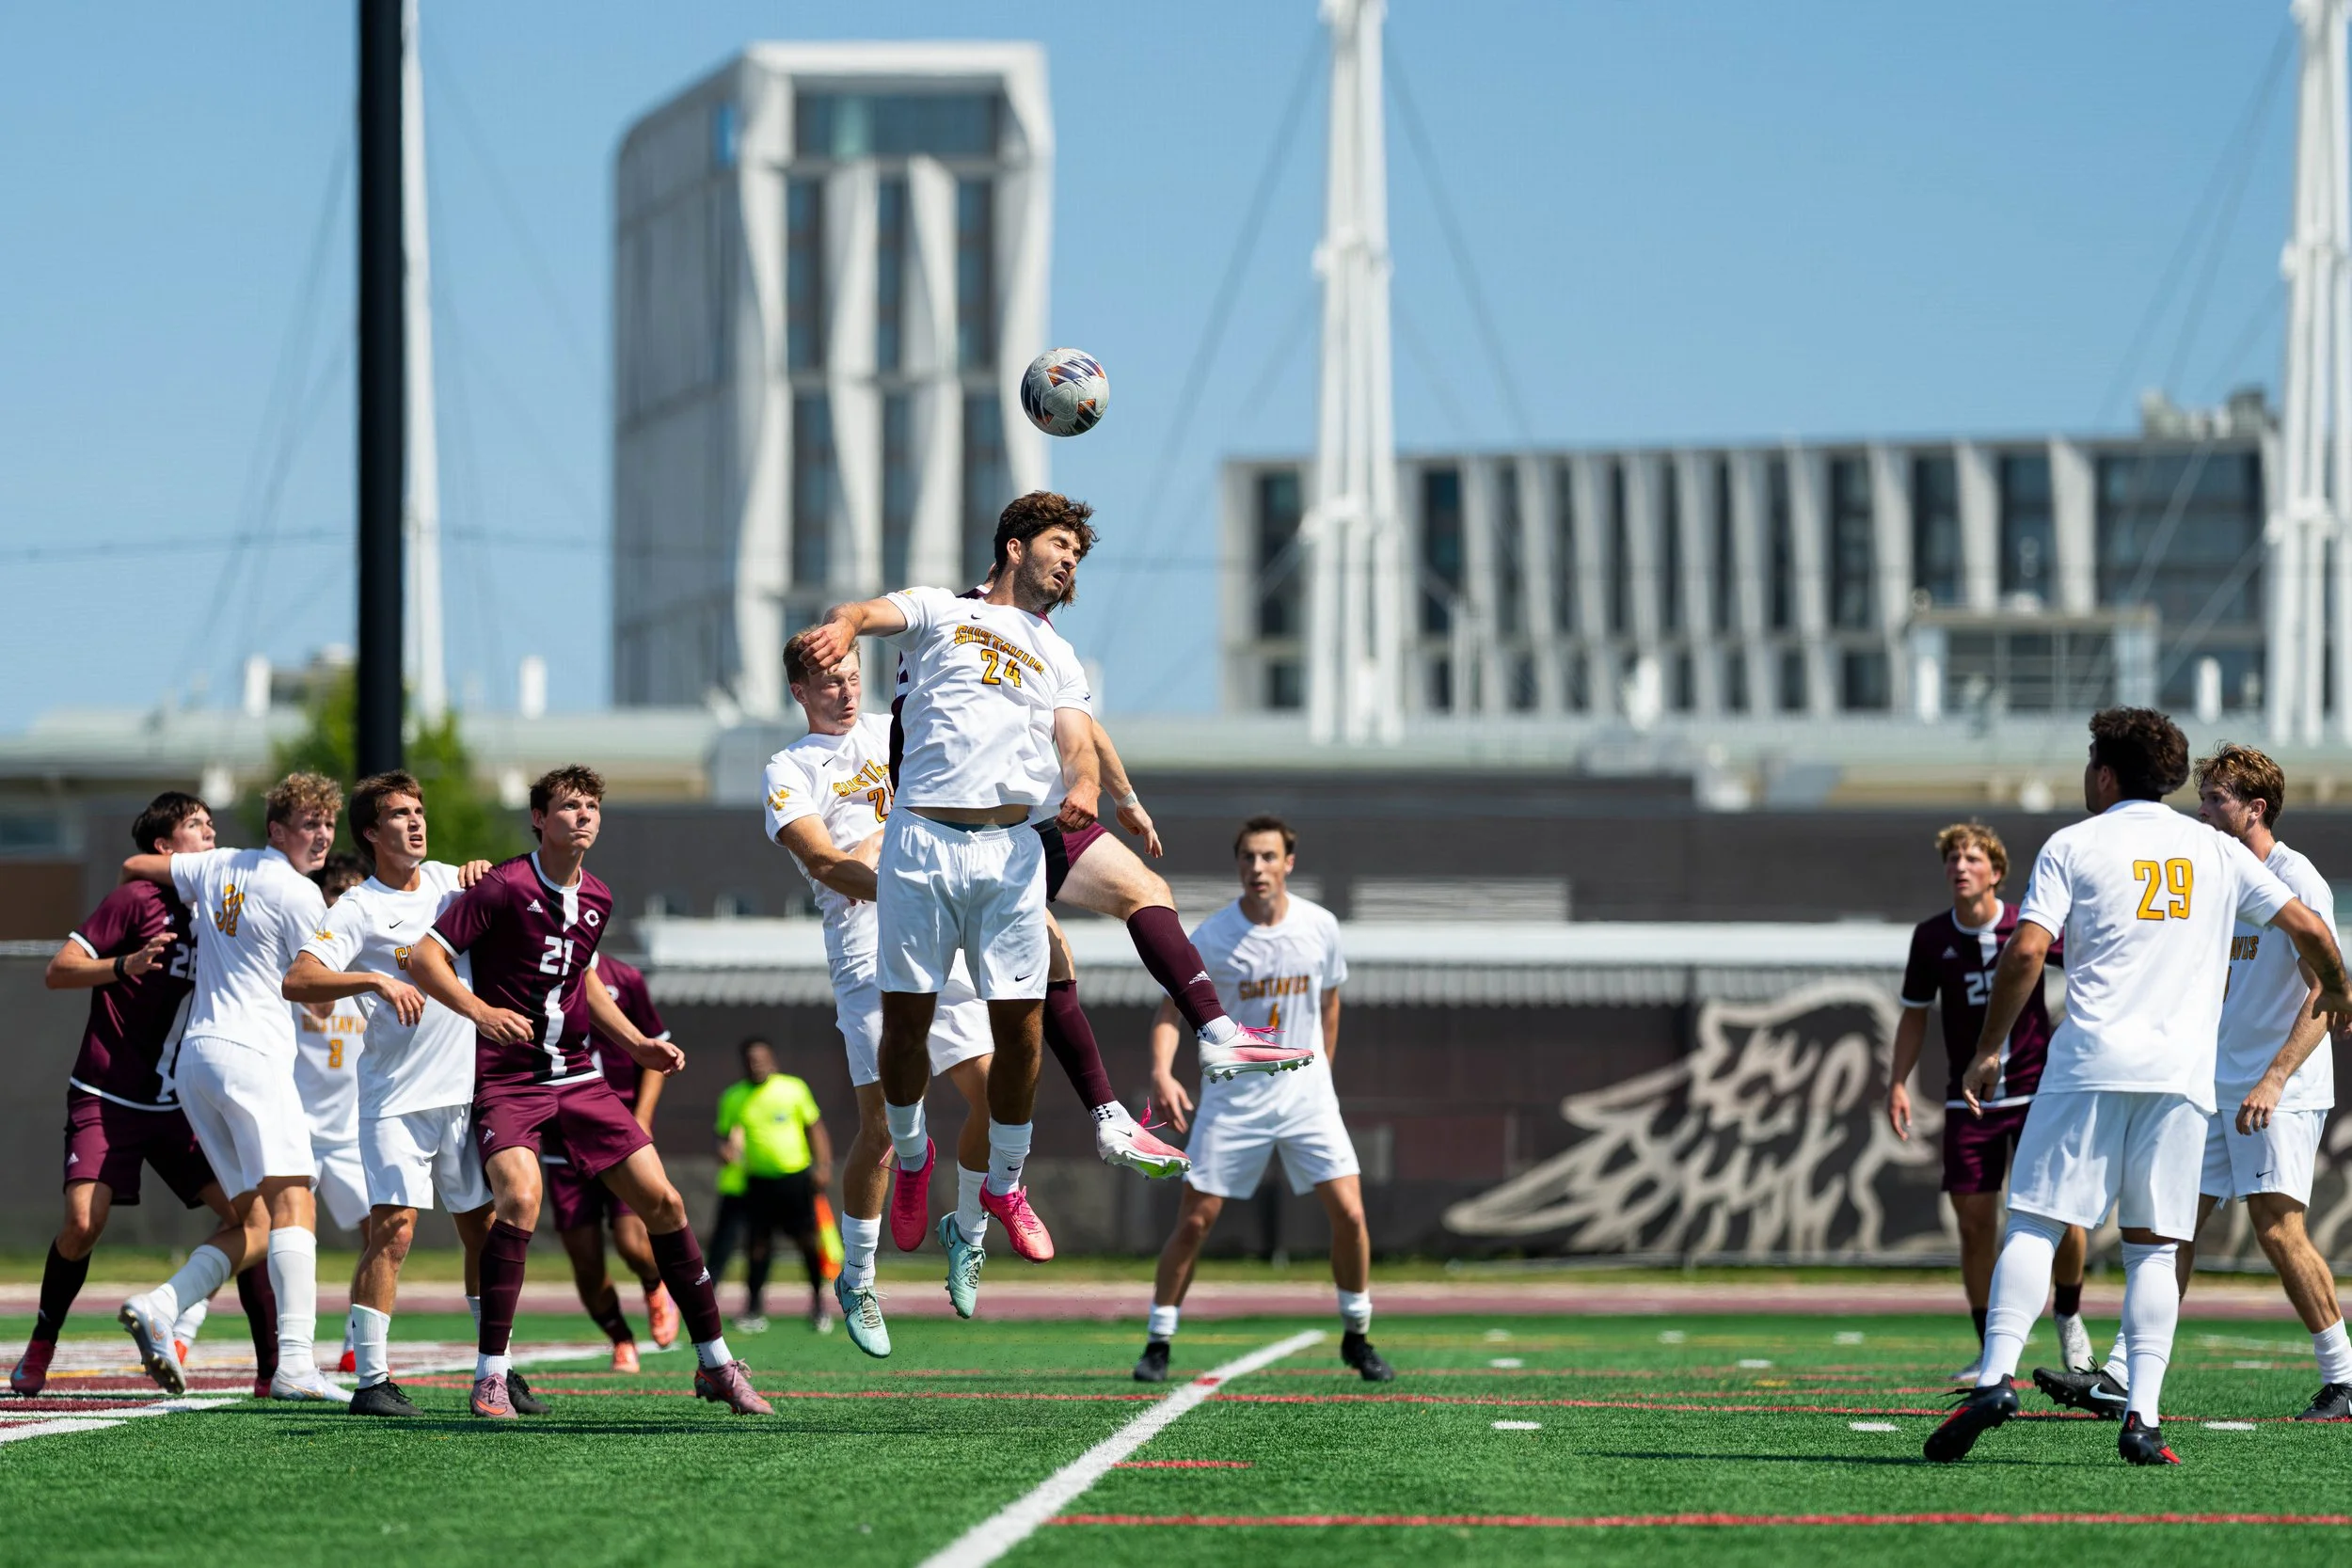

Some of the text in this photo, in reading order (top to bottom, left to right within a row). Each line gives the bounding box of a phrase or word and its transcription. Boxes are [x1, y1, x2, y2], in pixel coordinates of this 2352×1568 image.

[954, 625, 1044, 675] GUSTAVUS
[980, 649, 1022, 689] 24
[833, 758, 890, 798] GUSTA
[867, 786, 895, 824] 2
[2132, 857, 2194, 921] 29
[539, 935, 575, 976] 21
[2230, 935, 2259, 960] AVUS
[301, 1014, 366, 1035] GUSTAVU
[328, 1038, 343, 1069] 8
